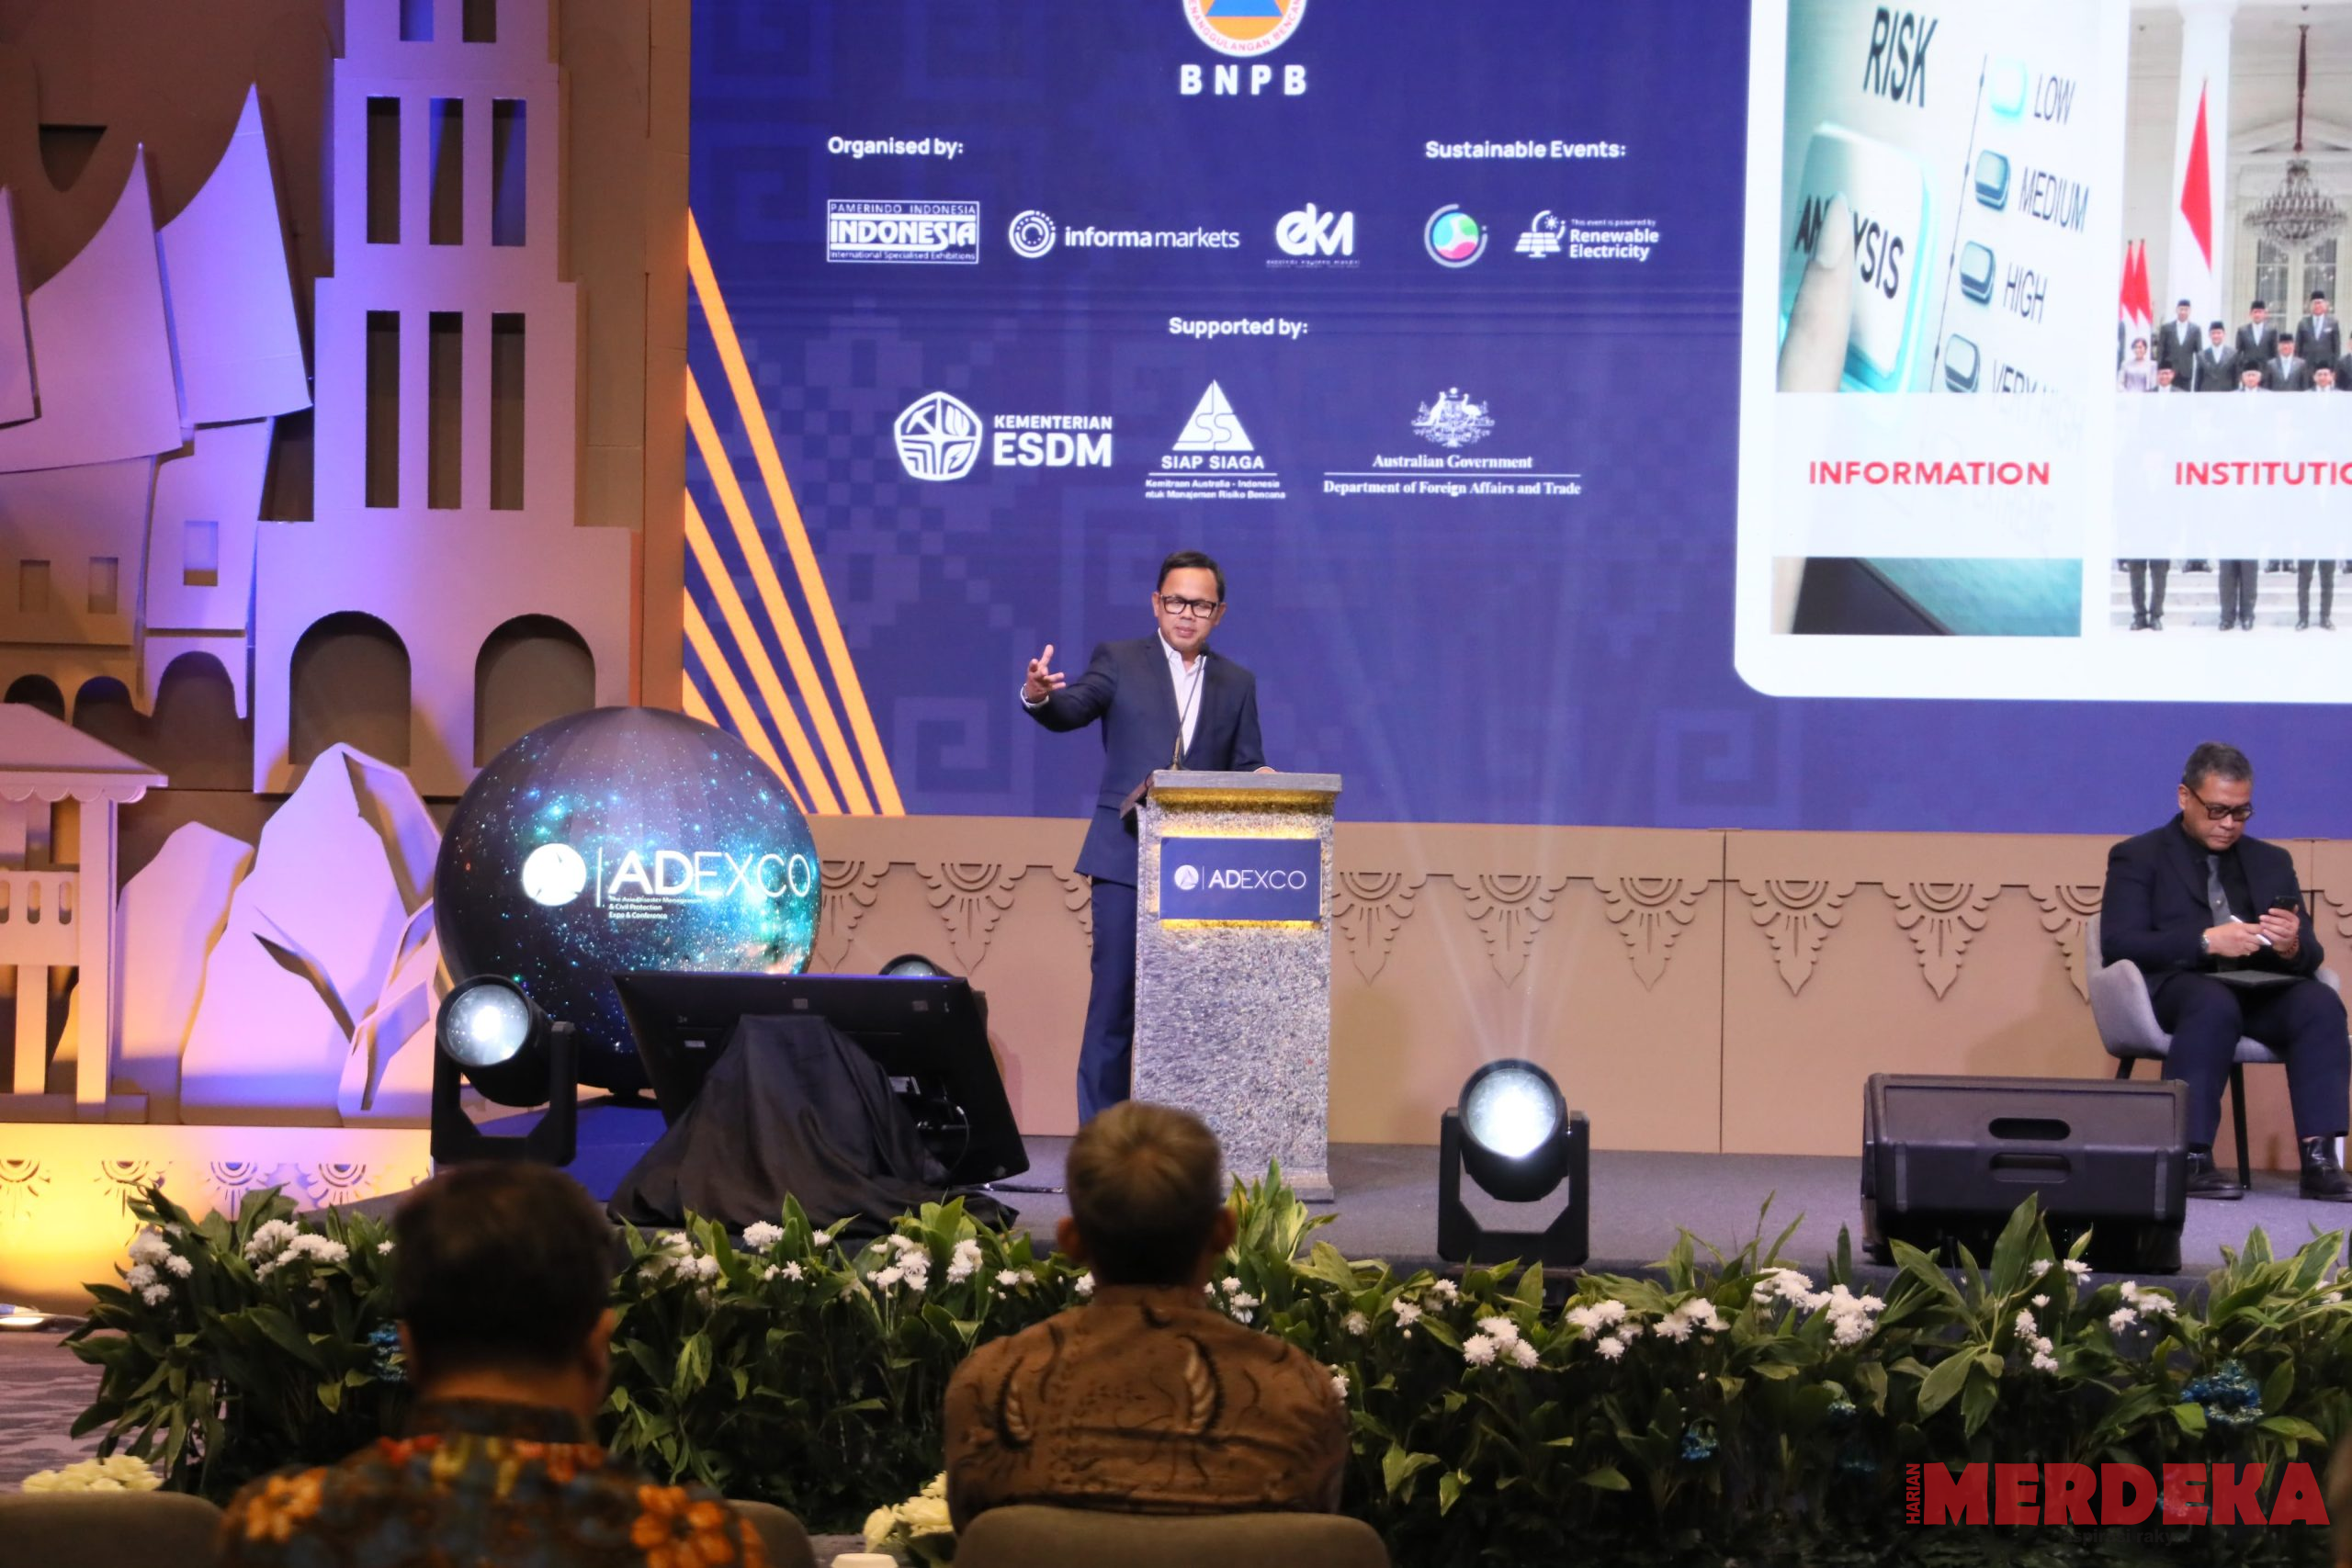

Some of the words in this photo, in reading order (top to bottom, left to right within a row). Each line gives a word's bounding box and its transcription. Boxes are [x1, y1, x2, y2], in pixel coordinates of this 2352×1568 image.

[1863, 5, 1938, 107] RISK
[1180, 63, 1306, 96] BNPB
[2033, 73, 2075, 125] LOW
[828, 136, 930, 159] Organised
[933, 138, 963, 160] by:
[1425, 141, 1546, 159] Sustainable
[1550, 141, 1626, 159] Events:
[831, 203, 902, 213] PAMERINDO
[910, 204, 976, 214] INDONESIA
[2018, 166, 2089, 233] MEDIUM
[830, 220, 977, 252] INDONESIA
[1570, 228, 1659, 243] Renewable
[1794, 193, 1905, 299] ANYSIS
[1570, 243, 1650, 262] Electricity
[2003, 261, 2048, 324] HIGH
[1169, 318, 1274, 338] Supported
[1278, 319, 1308, 340] by:
[994, 415, 1113, 429] KEMENTERIAN
[993, 433, 1113, 467] ESDM
[1161, 456, 1204, 469] SIAP
[1209, 456, 1265, 469] SIAGA
[1373, 455, 1442, 468] Australian
[1447, 456, 1532, 468] Government
[1192, 479, 1230, 488] Australia
[1238, 479, 1280, 488] Indonesia
[1809, 461, 2050, 485] INFORMATION
[1218, 490, 1246, 499] Risiko
[1323, 480, 1399, 496] Department
[1403, 481, 1417, 493] of
[1419, 481, 1466, 497] Foreign
[1470, 481, 1514, 494] Affairs
[1518, 482, 1543, 494] and
[1545, 482, 1581, 494] Trade
[608, 851, 811, 898] ADEXCO
[1208, 869, 1306, 890] ADEXCO
